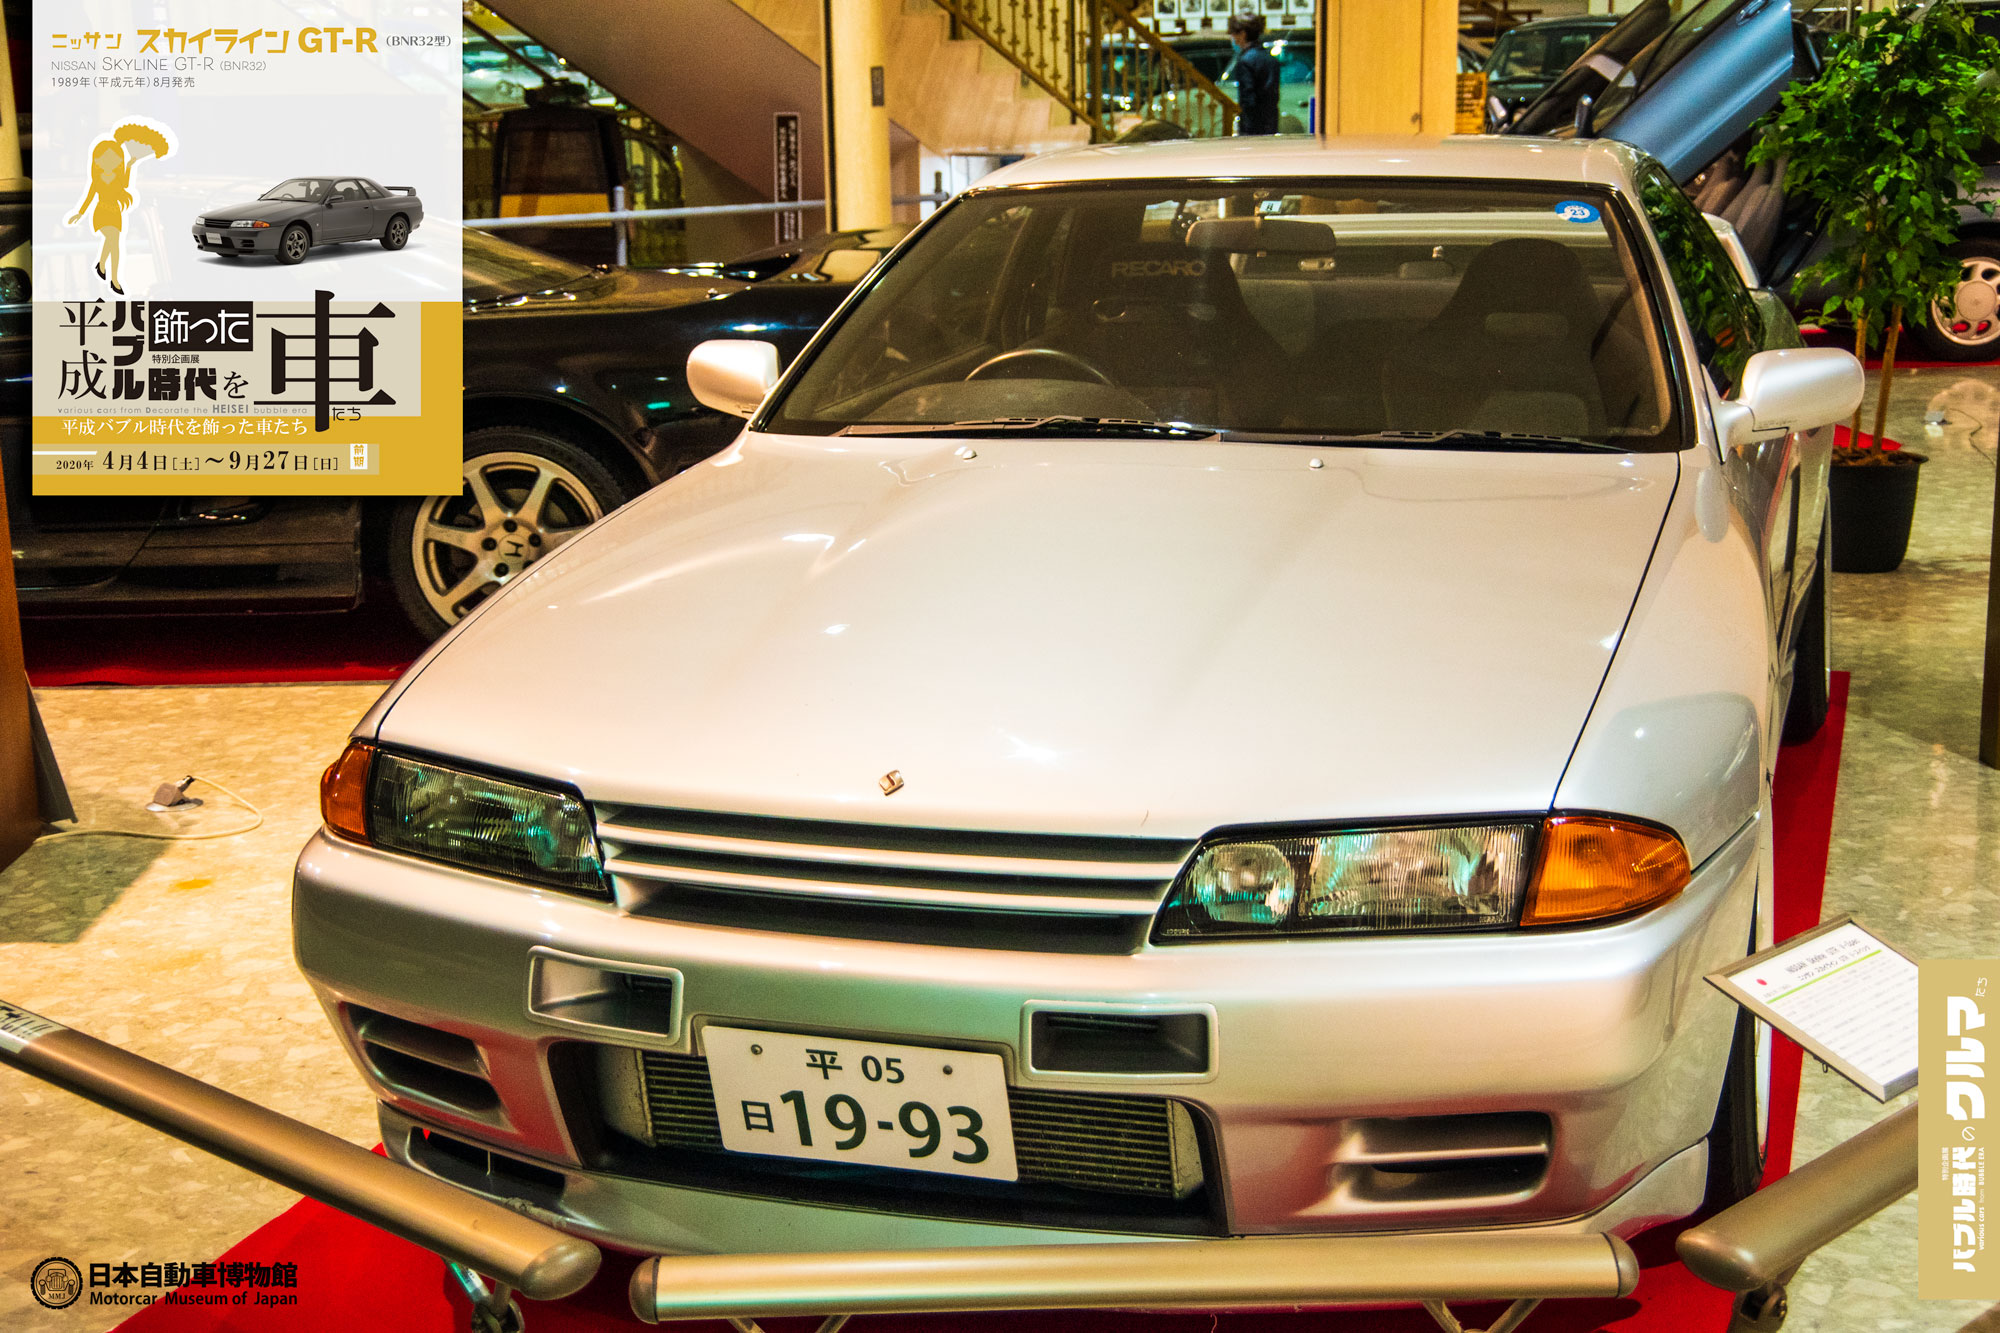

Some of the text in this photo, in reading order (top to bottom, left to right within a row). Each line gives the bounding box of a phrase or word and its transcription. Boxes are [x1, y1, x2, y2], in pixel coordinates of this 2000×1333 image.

[1111, 261, 1206, 278] RECARO
[805, 1048, 905, 1084] 平 05
[741, 1089, 989, 1165] 日 19-93
